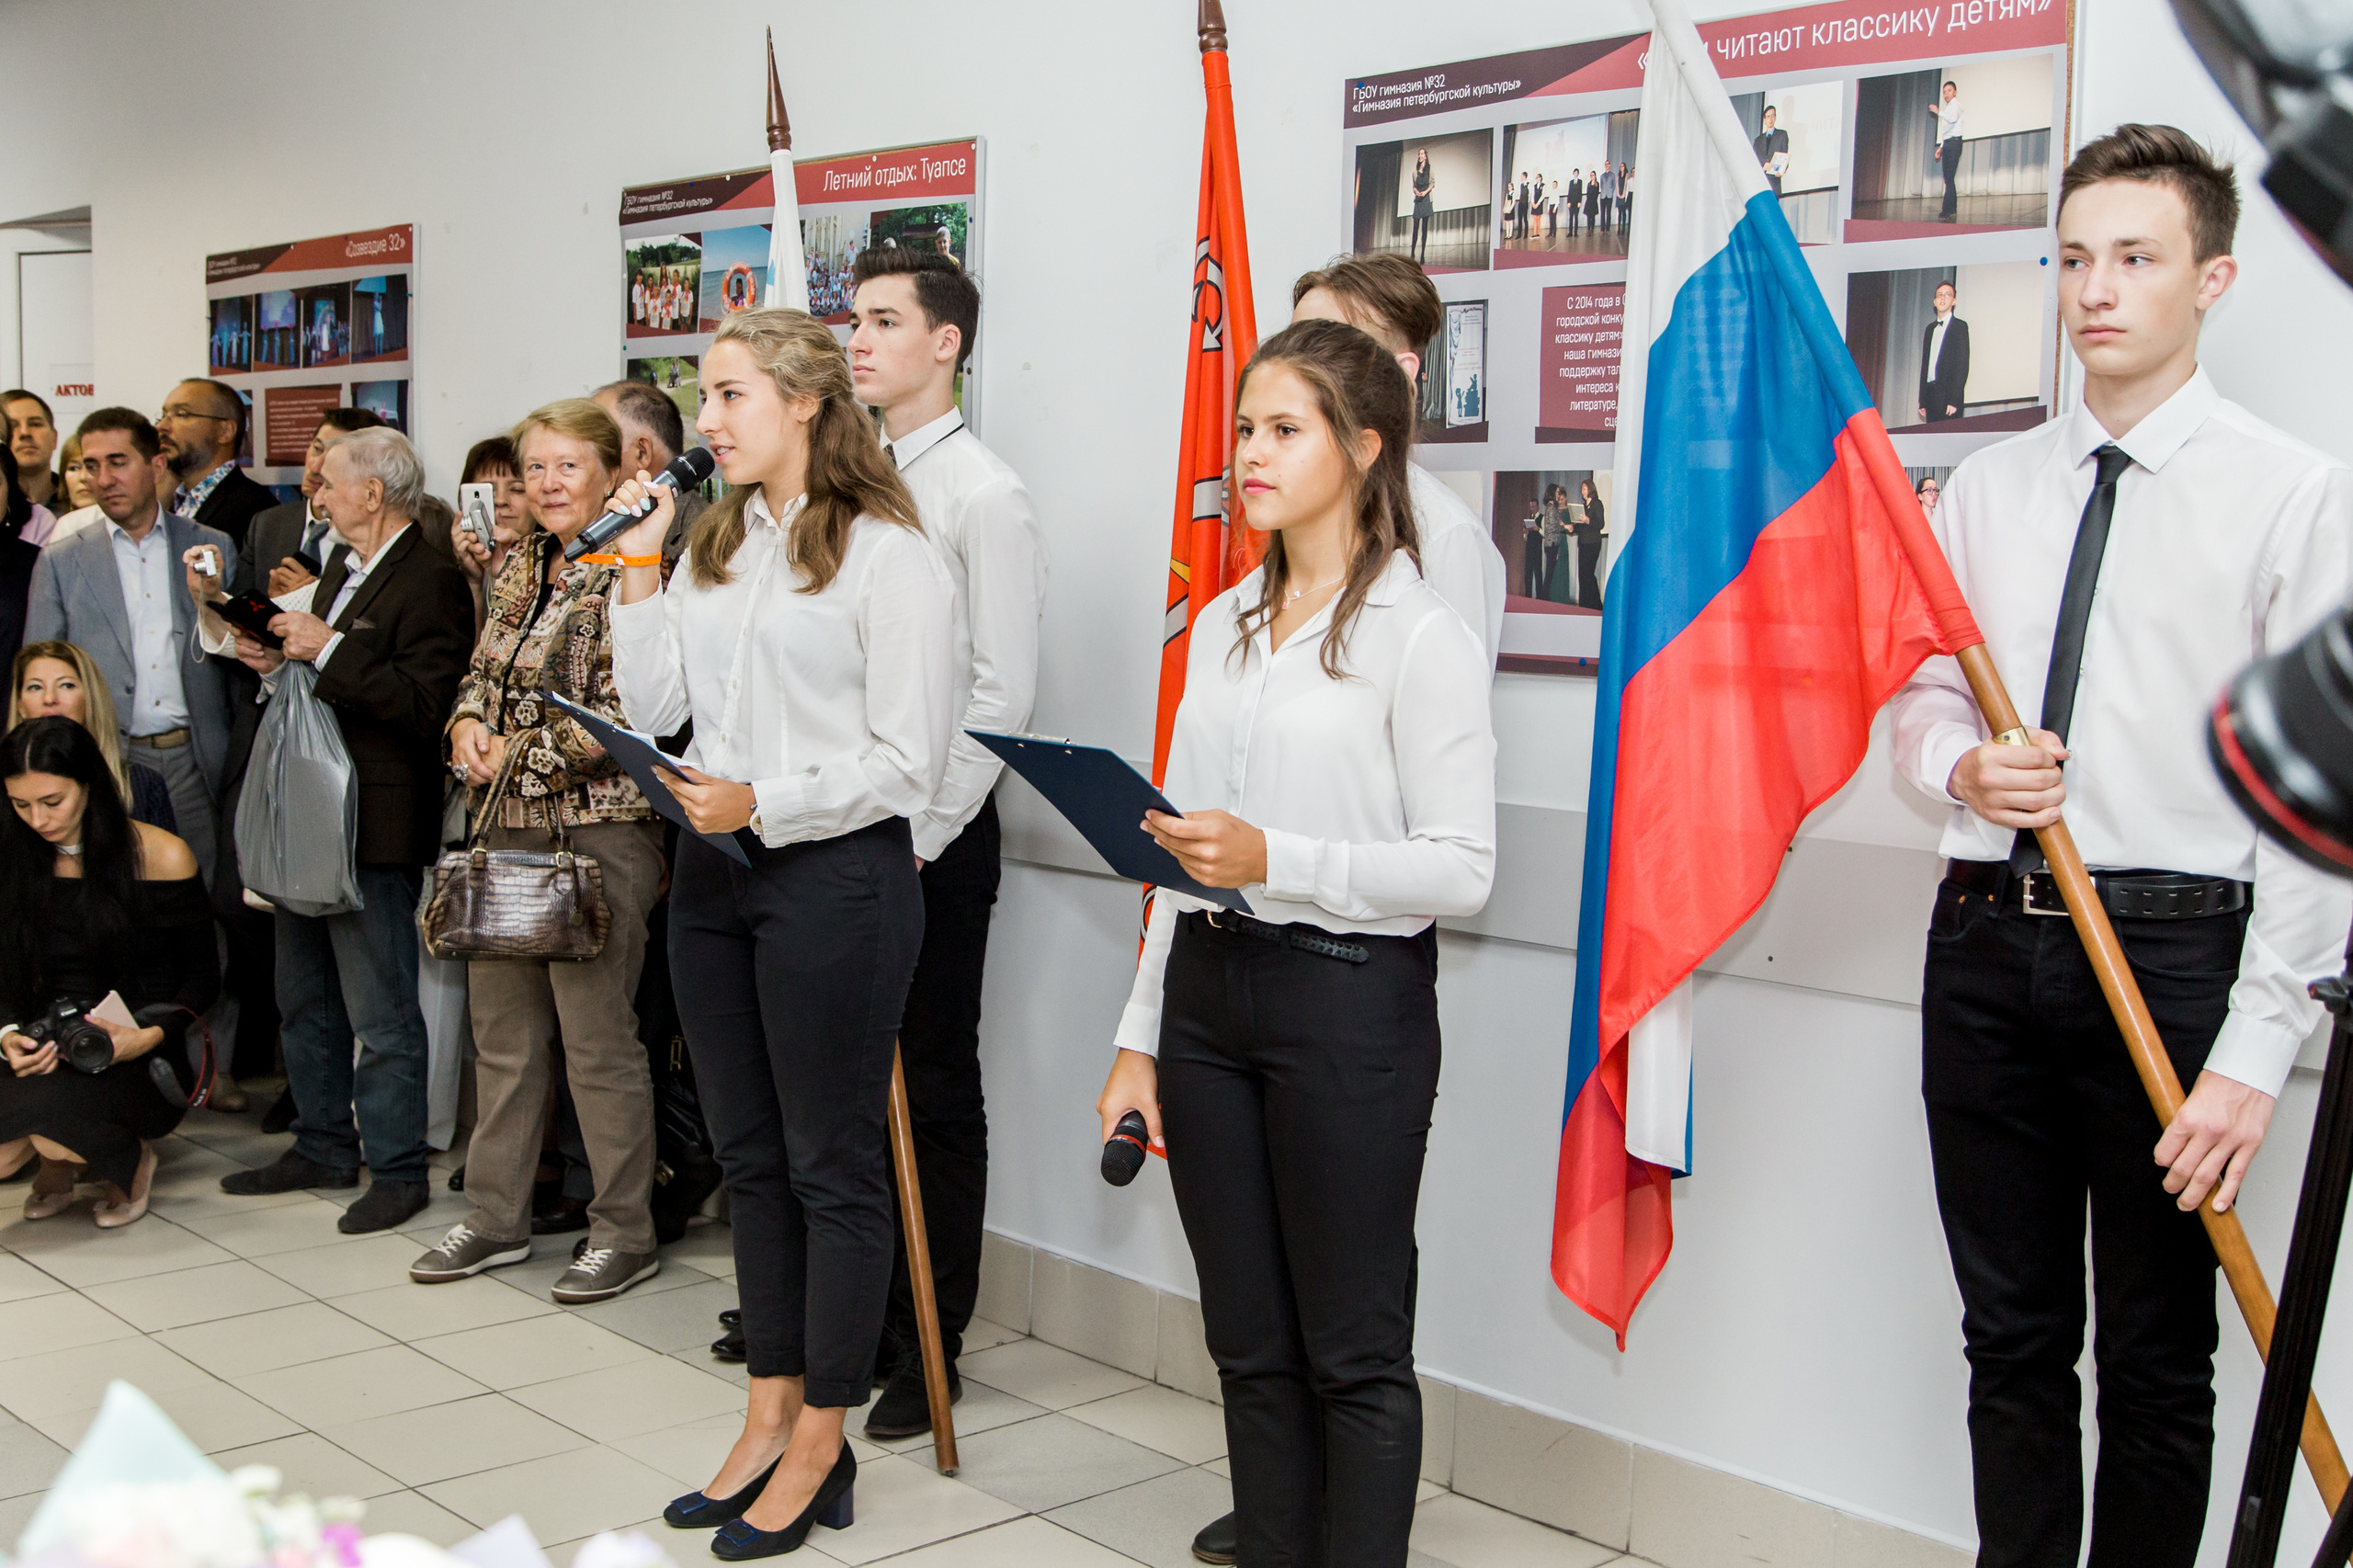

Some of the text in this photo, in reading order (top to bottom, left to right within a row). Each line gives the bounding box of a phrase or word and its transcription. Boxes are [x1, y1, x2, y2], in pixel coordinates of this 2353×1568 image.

[1716, 26, 1805, 61] читают
[1812, 6, 1940, 46] классику
[1947, 0, 2052, 33] детям»
[1379, 80, 1423, 97] гимназия
[1424, 74, 1446, 89] №32
[1352, 79, 1522, 113] «Гимназия петербургской культуры»
[823, 157, 966, 192] Летний отдых: Туапсе
[388, 233, 406, 252] 32»
[1566, 296, 1574, 310] С
[1574, 295, 1593, 310] 2014
[1594, 296, 1613, 309] года
[1615, 296, 1620, 307] в
[1556, 312, 1600, 329] городской
[1554, 332, 1594, 346] классику
[1563, 349, 1586, 360] наша
[1559, 366, 1606, 379] поддержку
[1575, 382, 1614, 396] интереса
[1569, 400, 1619, 413] литературе,
